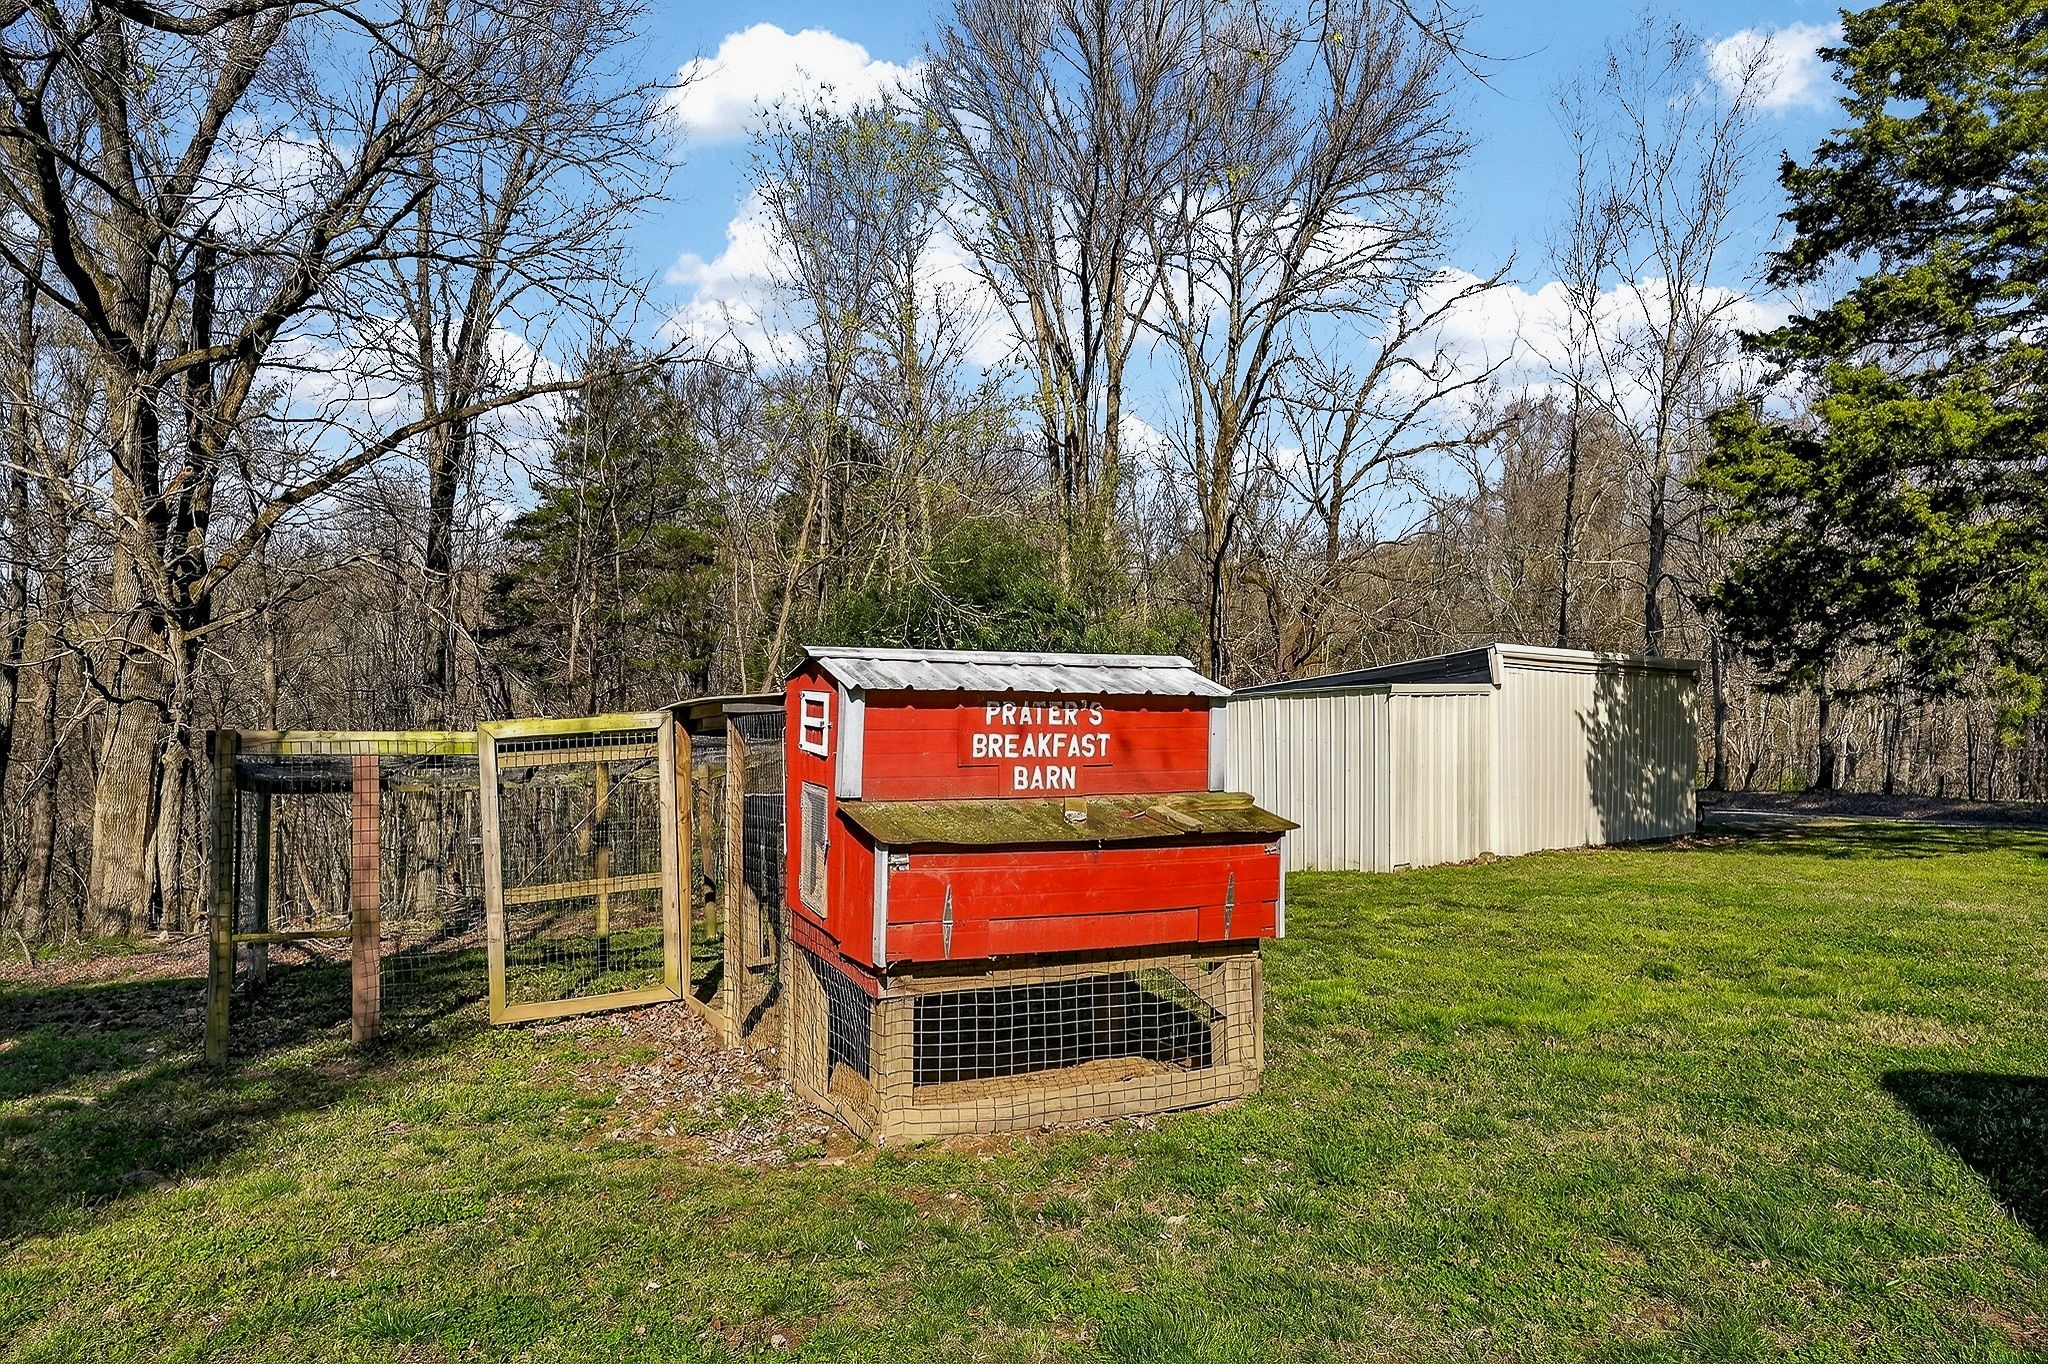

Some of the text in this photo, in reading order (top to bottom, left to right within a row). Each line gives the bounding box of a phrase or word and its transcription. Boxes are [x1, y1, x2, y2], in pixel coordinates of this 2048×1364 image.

[985, 700, 1103, 726] PRATER'S
[972, 733, 1110, 758] BREAKFAST
[1013, 765, 1076, 790] BARN
